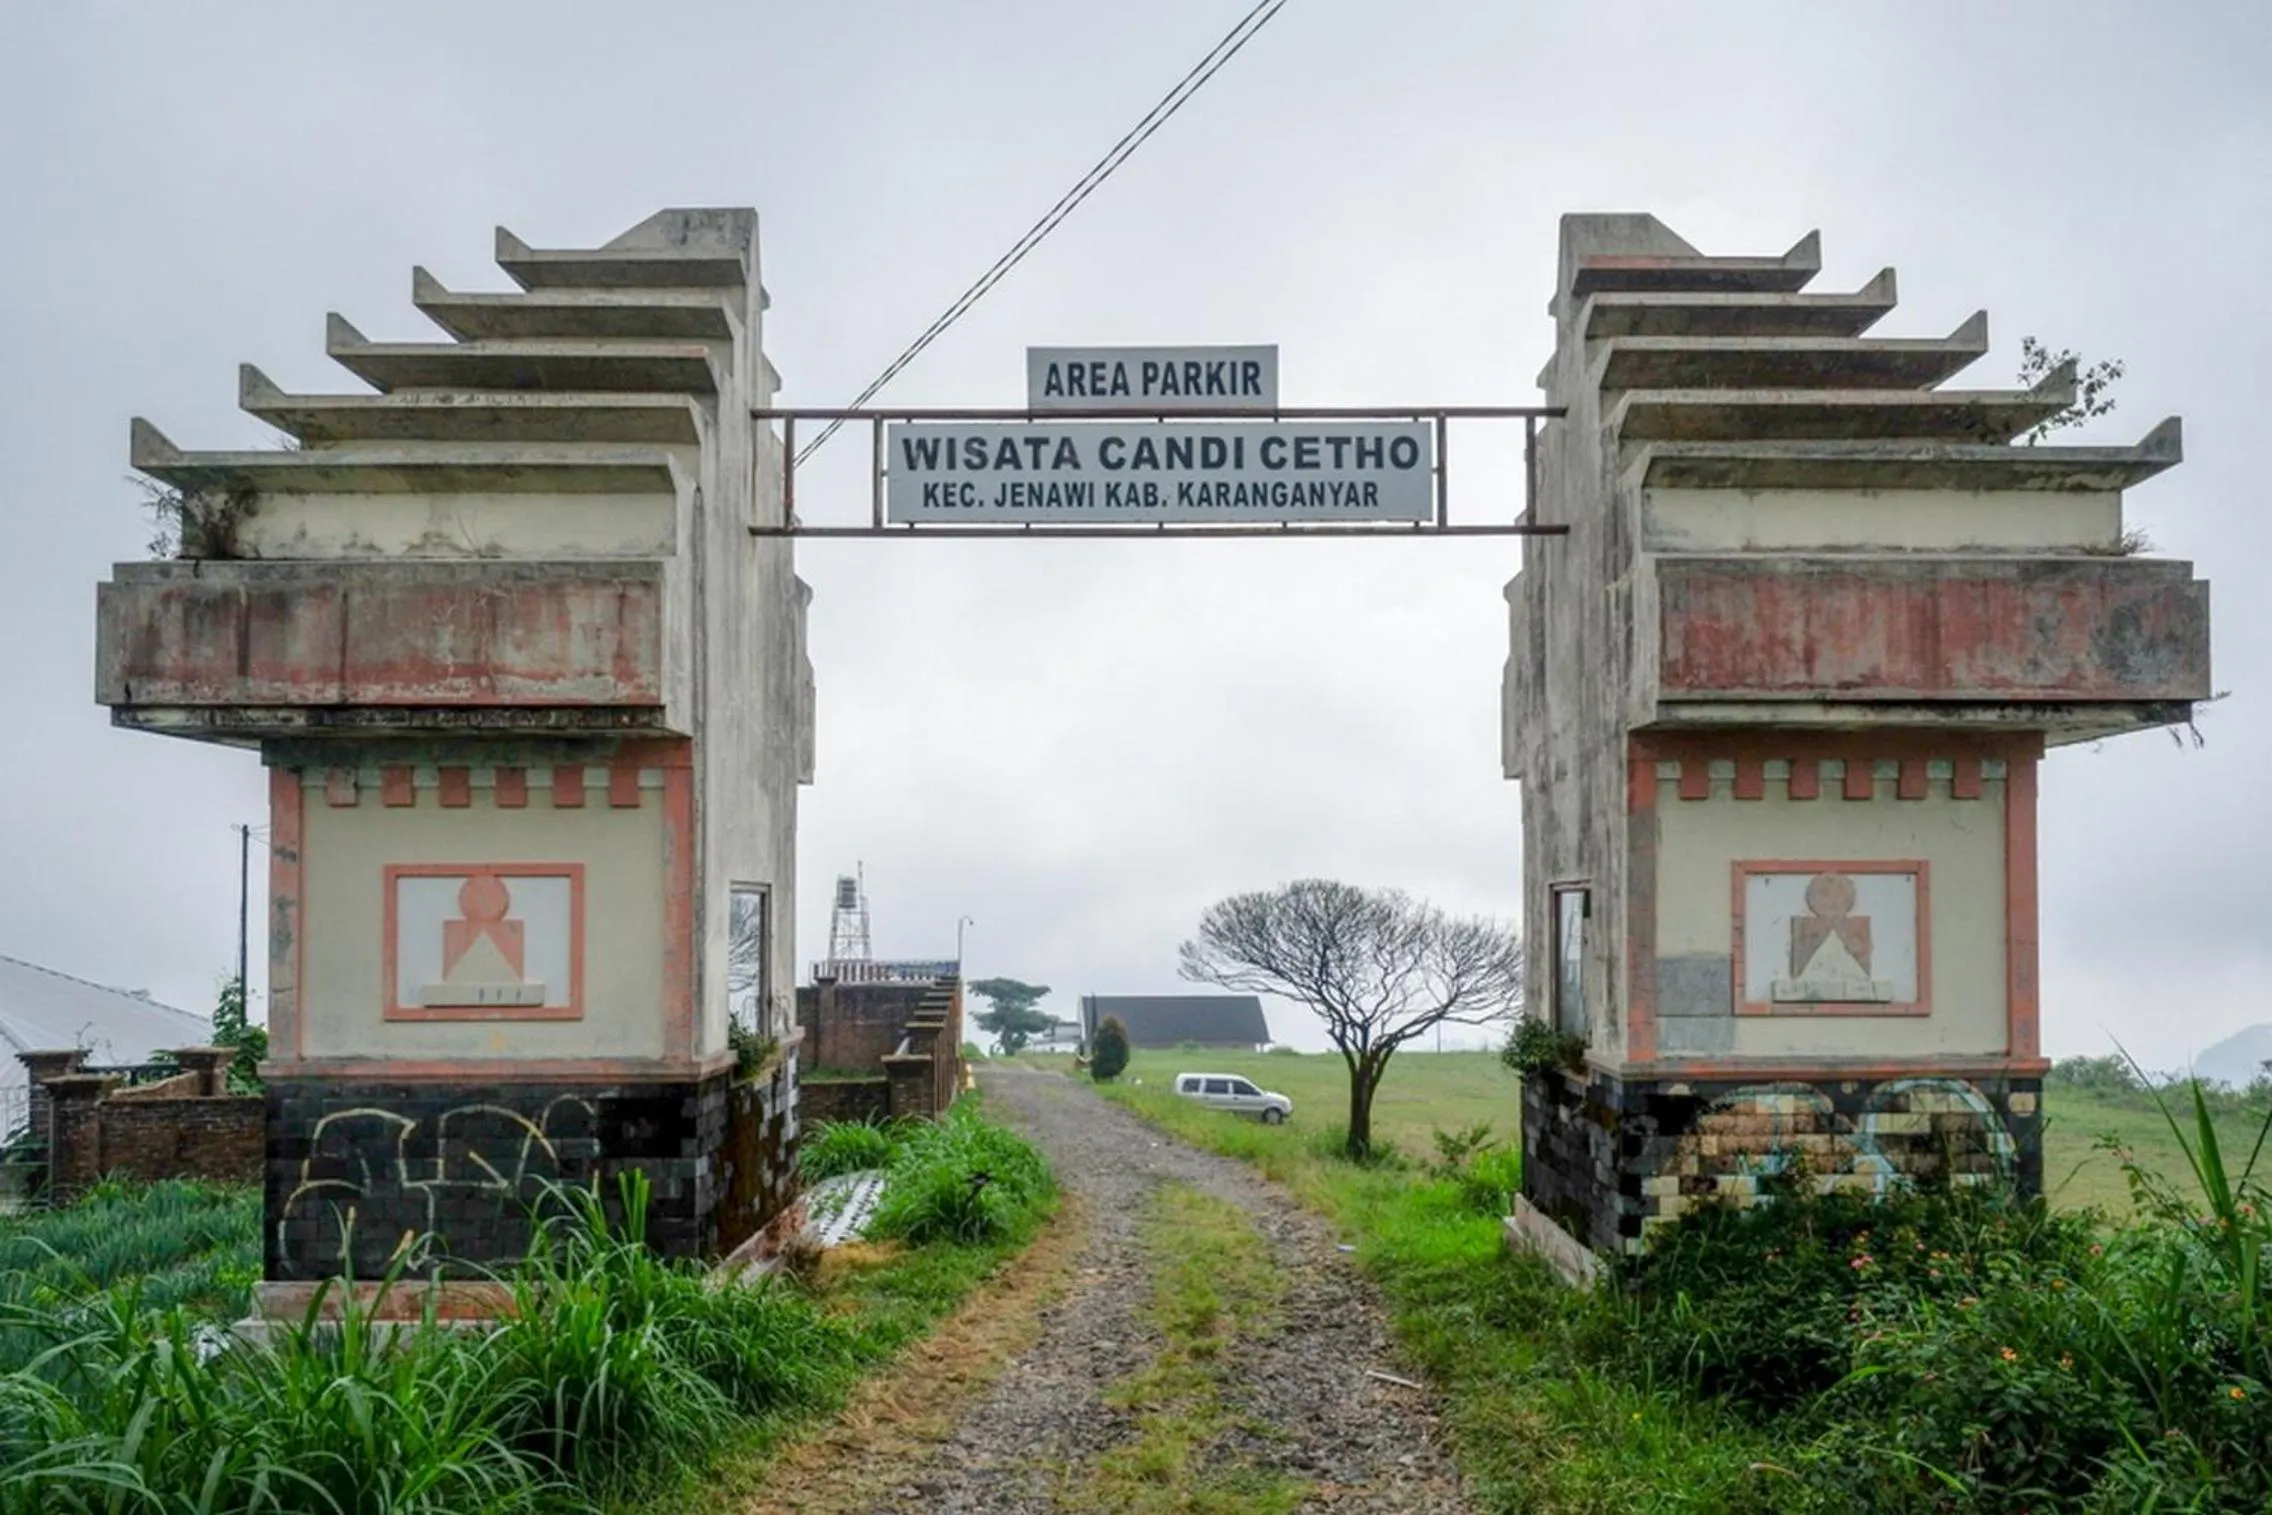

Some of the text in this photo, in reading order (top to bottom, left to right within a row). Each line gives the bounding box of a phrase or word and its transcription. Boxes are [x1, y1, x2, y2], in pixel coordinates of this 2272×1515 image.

[1043, 360, 1262, 398] AREA PARKIR
[901, 435, 1420, 472] WISATA CANDI CETHO
[923, 481, 1379, 509] KEC. JENAWI KAB. KARANGANYAR
